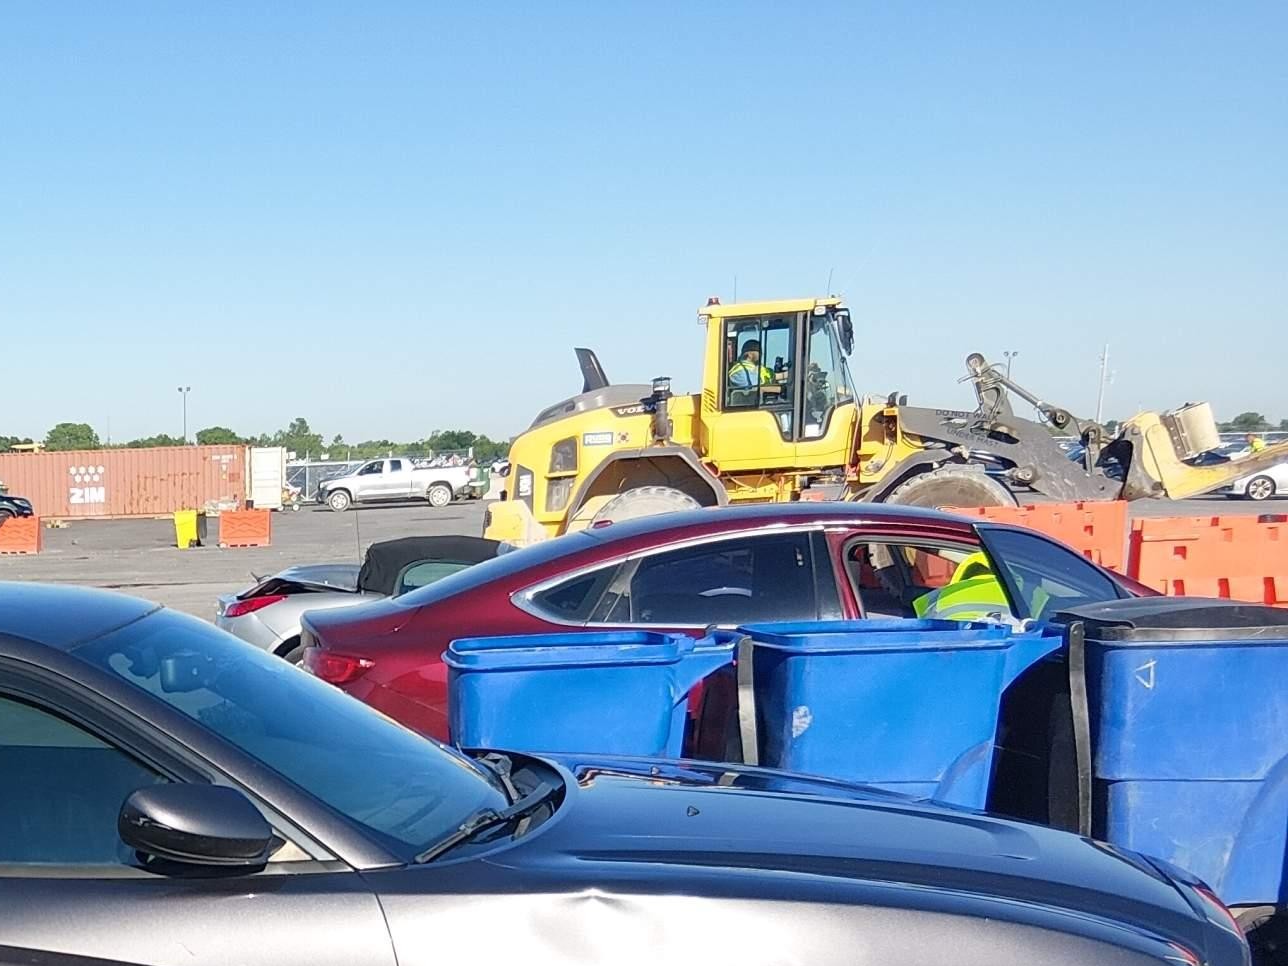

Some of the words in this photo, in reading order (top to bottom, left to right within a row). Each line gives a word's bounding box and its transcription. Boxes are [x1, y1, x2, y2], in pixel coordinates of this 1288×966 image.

[617, 404, 657, 414] VOLV
[951, 410, 969, 418] NOT
[69, 486, 105, 504] ZIM
